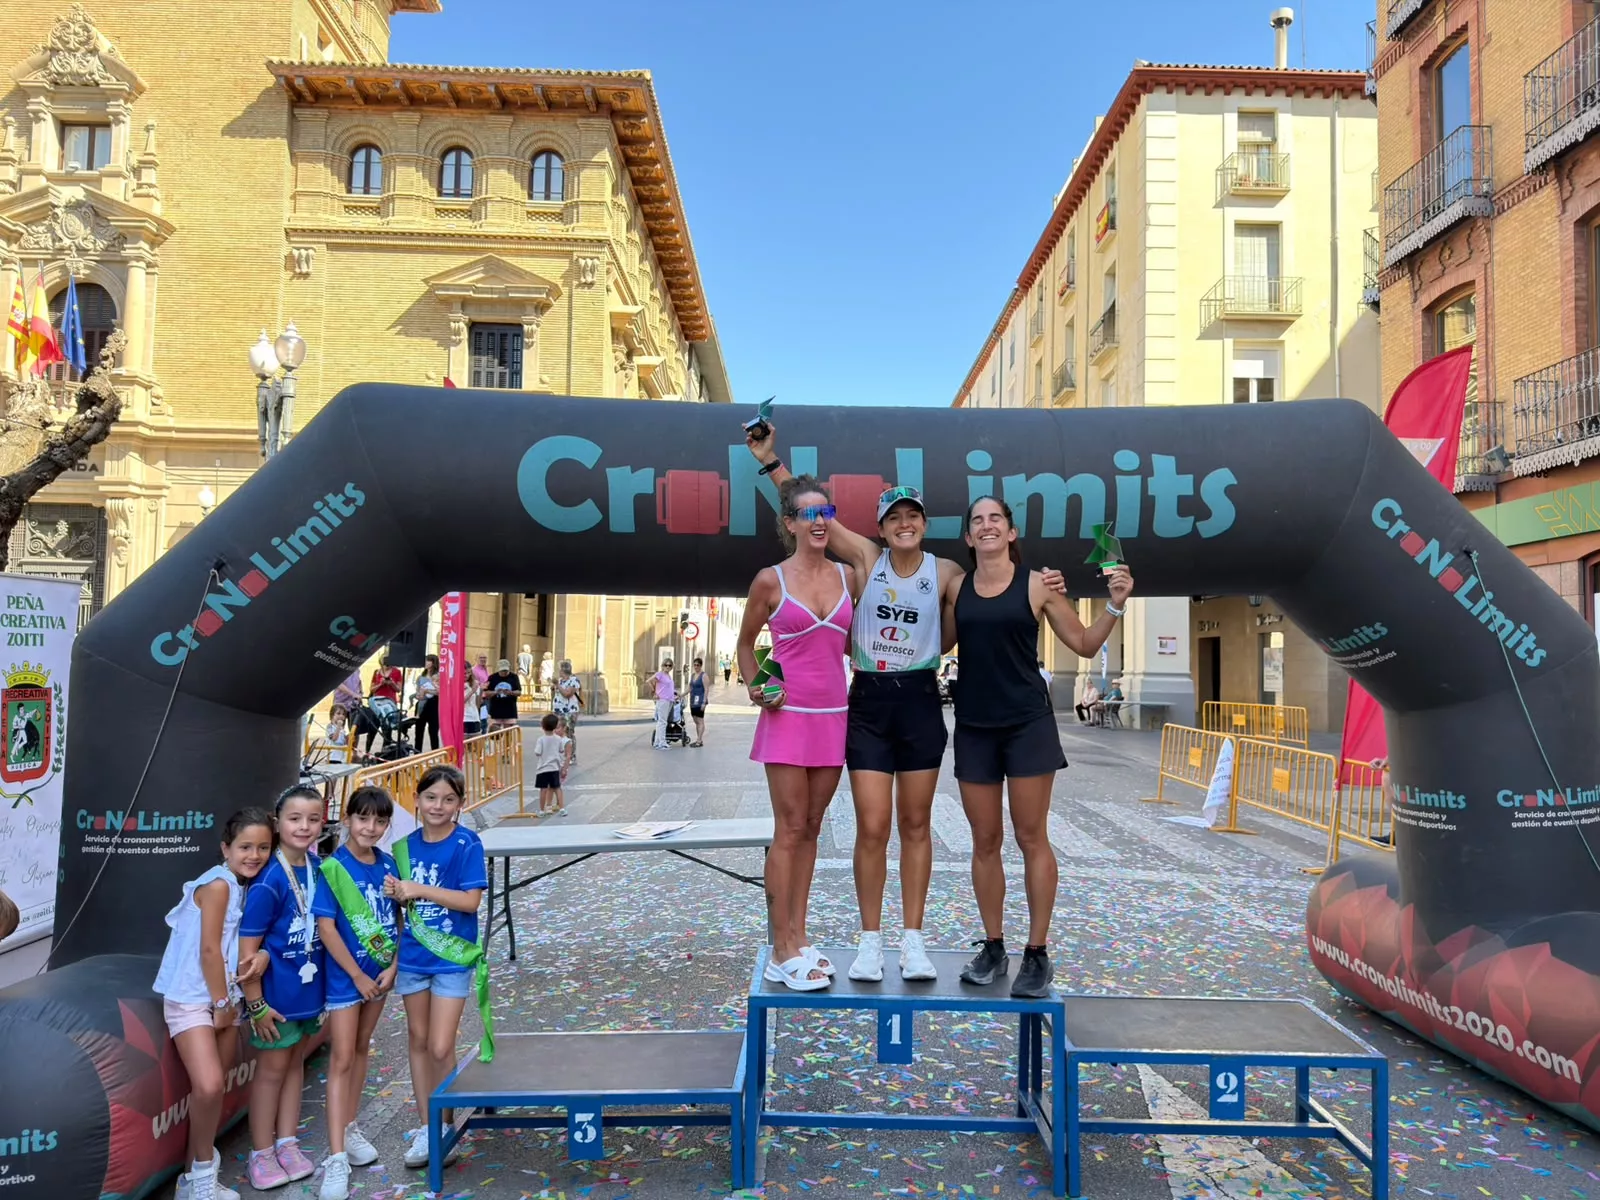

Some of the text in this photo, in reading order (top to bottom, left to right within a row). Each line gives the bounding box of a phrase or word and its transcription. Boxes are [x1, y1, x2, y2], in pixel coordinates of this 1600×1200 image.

[6, 592, 45, 611] PEÑA
[876, 604, 919, 624] SYB
[7, 632, 45, 647] ZOITI
[872, 640, 915, 656] Literosca
[5, 689, 49, 699] RECREATIVA
[1514, 811, 1545, 819] Servicio
[1546, 810, 1557, 818] de
[1511, 820, 1541, 828] gestión
[85, 834, 191, 844] Servicio de cronometraje y
[81, 845, 200, 855] gestión de eventos deportivos
[1312, 935, 1582, 1085] www.cronolimits2020.com
[886, 1013, 902, 1045] 1
[1216, 1071, 1239, 1103] 2
[573, 1112, 597, 1144] 3
